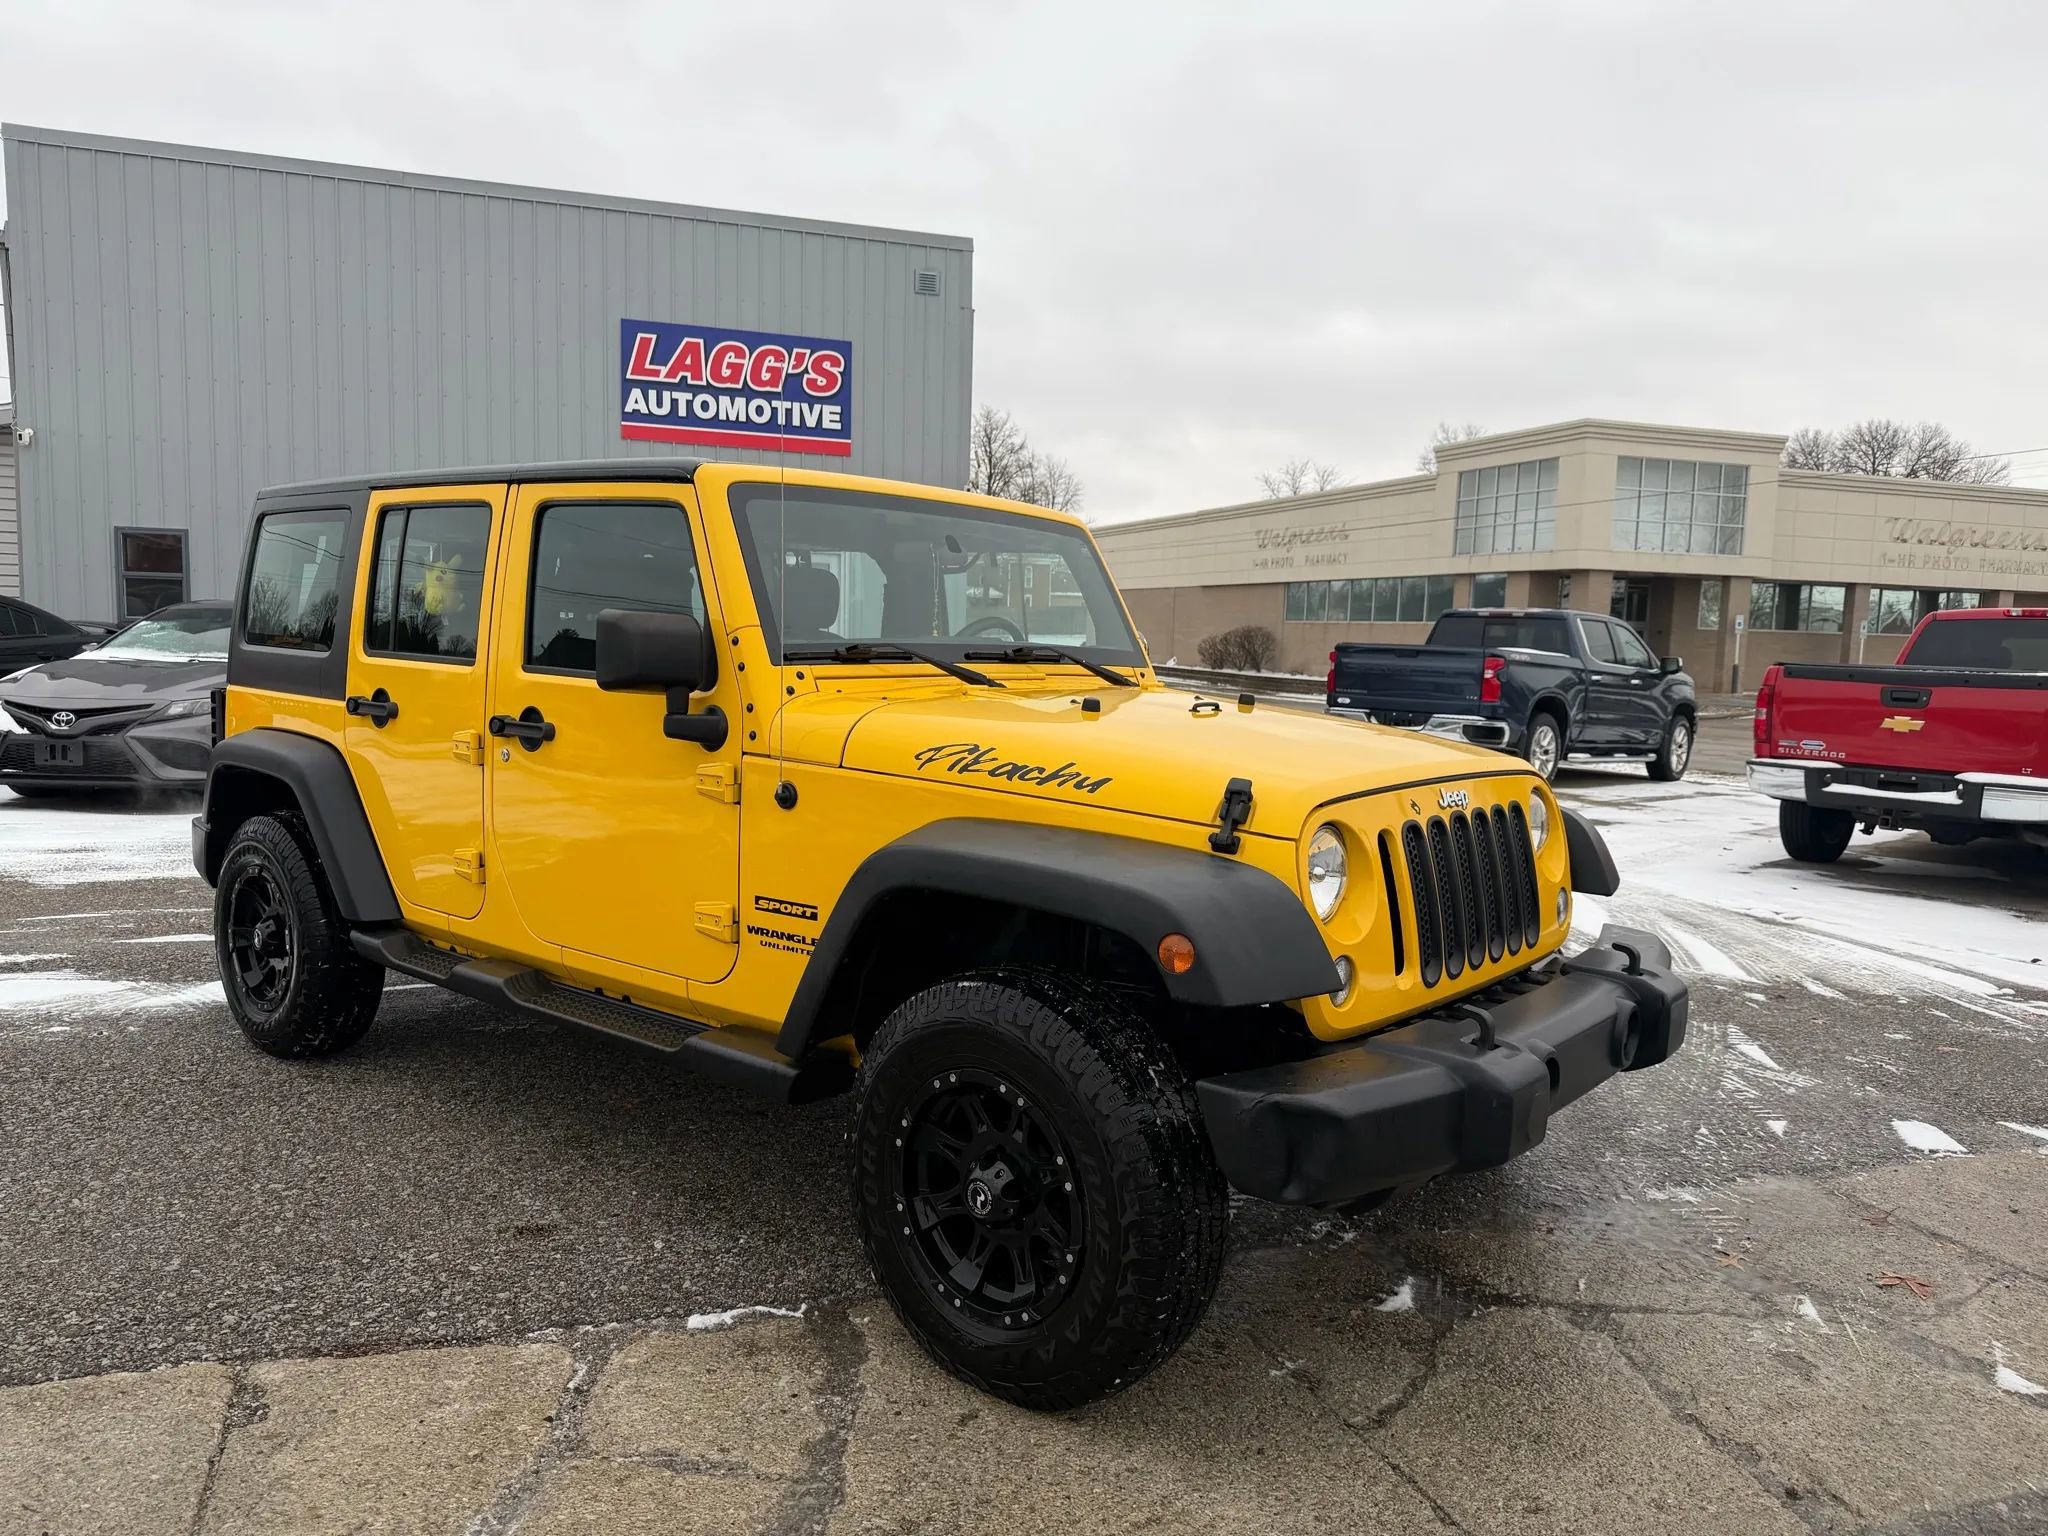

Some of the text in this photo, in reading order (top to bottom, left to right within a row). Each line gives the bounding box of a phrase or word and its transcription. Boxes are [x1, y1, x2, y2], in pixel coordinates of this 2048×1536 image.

[626, 333, 845, 396] LAGG'S
[624, 388, 842, 430] AUTOMOTIVE
[1254, 522, 1349, 552] Walgreens
[1885, 516, 2047, 555] Walgreens
[1923, 554, 1969, 570] PHOTO
[1777, 747, 1846, 759] SILVERADO
[914, 743, 1113, 793] Pikachu
[1438, 787, 1468, 810] Jeep
[757, 898, 814, 918] SPORT
[746, 924, 819, 947] WRANGLE
[760, 940, 814, 957] UNLIMITE
